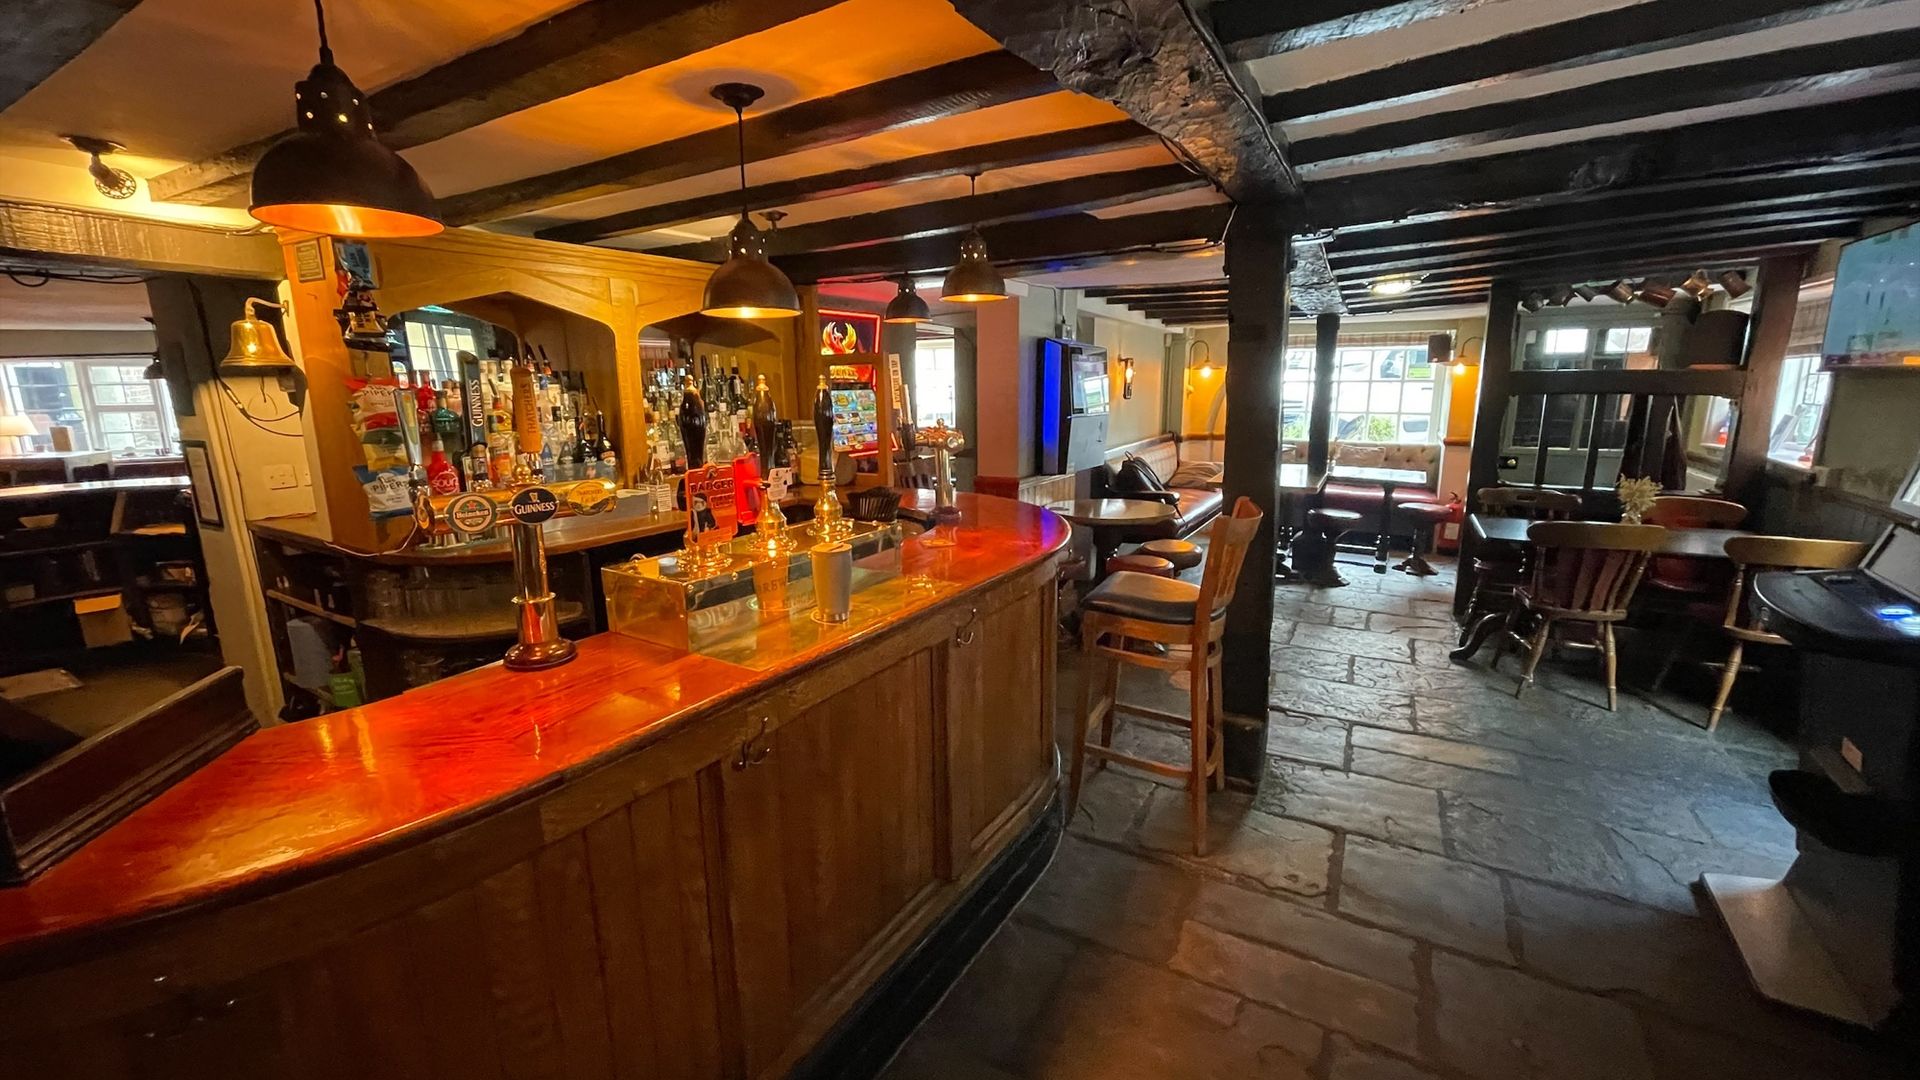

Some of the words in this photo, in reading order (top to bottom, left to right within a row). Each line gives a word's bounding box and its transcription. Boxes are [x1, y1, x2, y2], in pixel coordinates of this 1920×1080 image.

[469, 379, 484, 427] GUINNESS
[521, 383, 537, 434] THATCHERS
[689, 479, 734, 494] BADGER
[514, 501, 556, 515] GUINNESS
